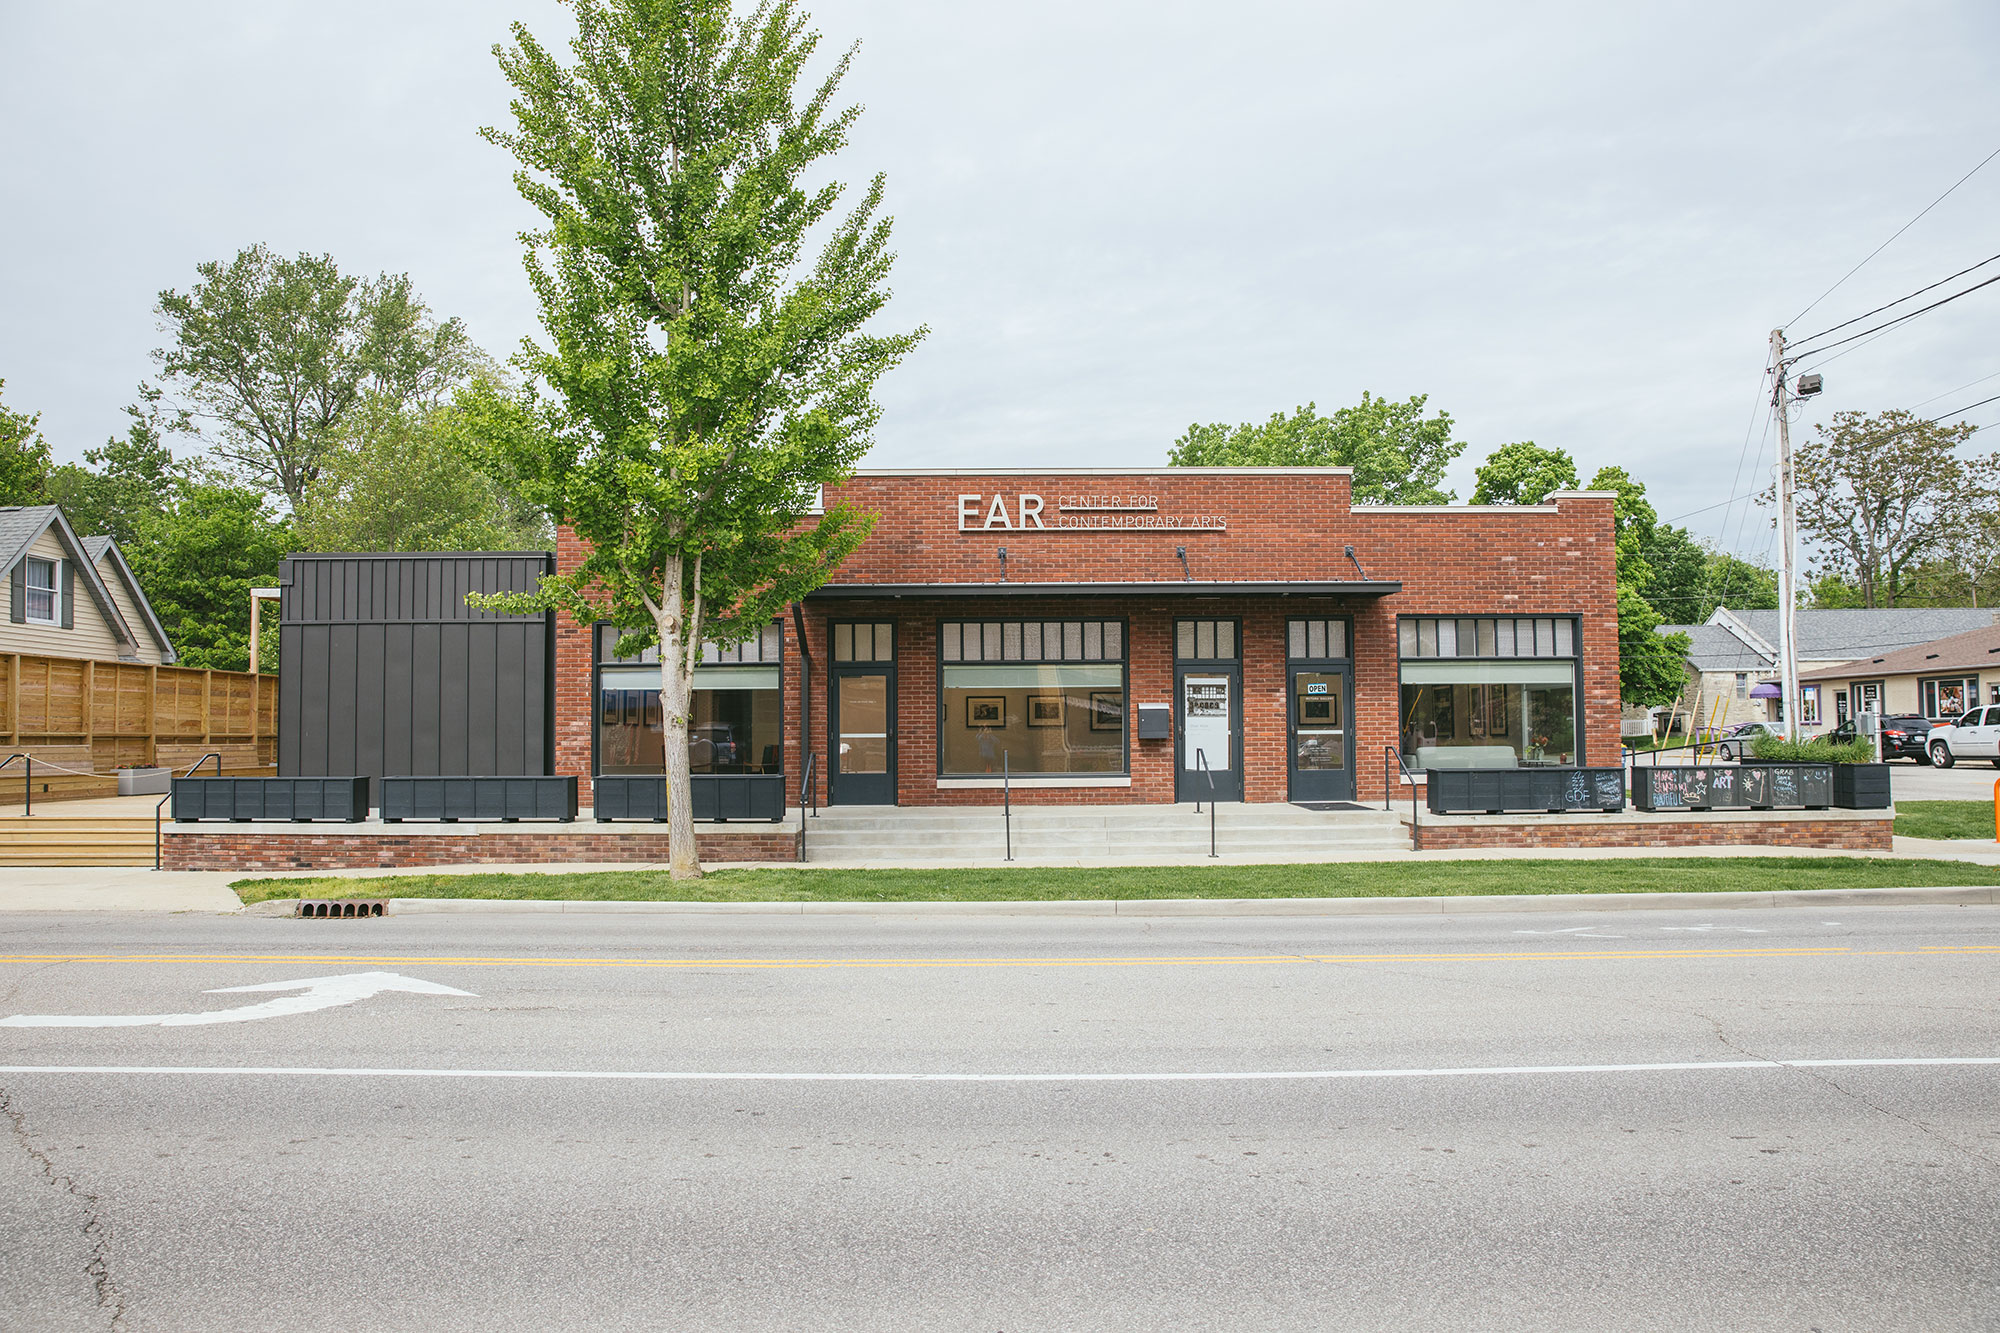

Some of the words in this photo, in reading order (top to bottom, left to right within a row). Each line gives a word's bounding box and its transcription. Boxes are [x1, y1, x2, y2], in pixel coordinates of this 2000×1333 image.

[1059, 495, 1121, 508] CENTER
[1130, 495, 1158, 508] FOR
[958, 494, 1045, 530] FAR
[1059, 516, 1184, 529] CONTEMPORARY
[1191, 516, 1227, 529] ARTS
[1774, 768, 1794, 776] GRAB
[1712, 776, 1734, 789] ART
[1565, 790, 1590, 802] GDF
